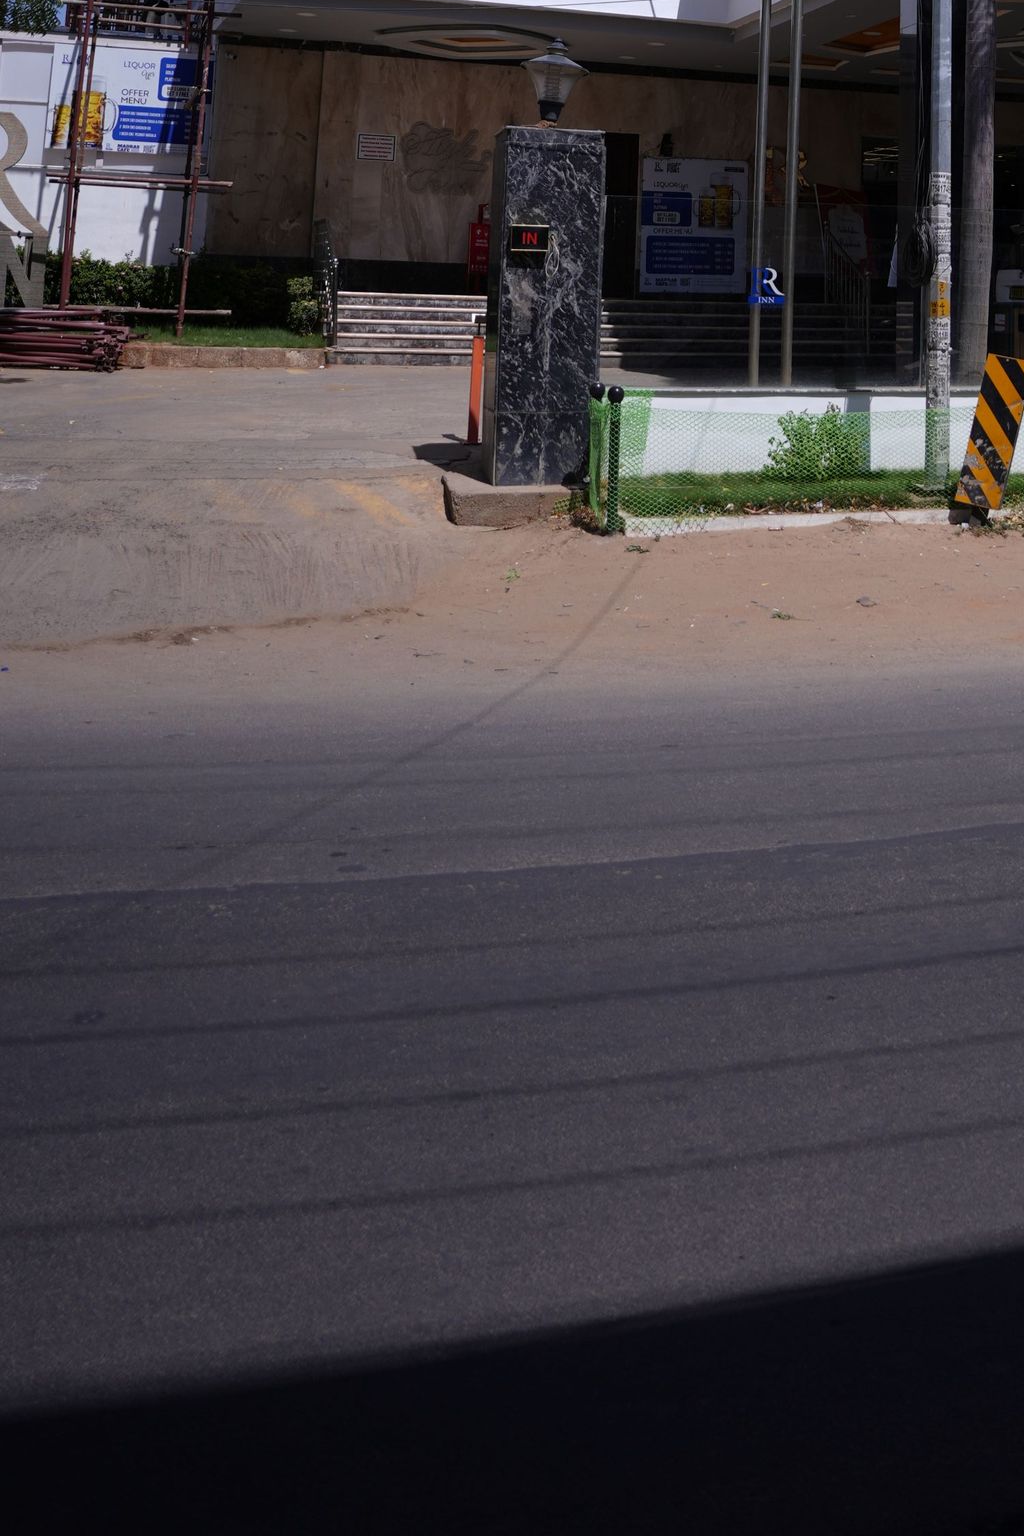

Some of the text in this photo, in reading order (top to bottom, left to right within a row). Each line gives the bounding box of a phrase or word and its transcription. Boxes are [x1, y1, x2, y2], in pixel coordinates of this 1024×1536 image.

[123, 60, 156, 70] LIQUOR
[121, 88, 150, 97] OFFER
[120, 96, 147, 105] MENU
[521, 231, 539, 245] IN
[758, 296, 775, 304] INN
